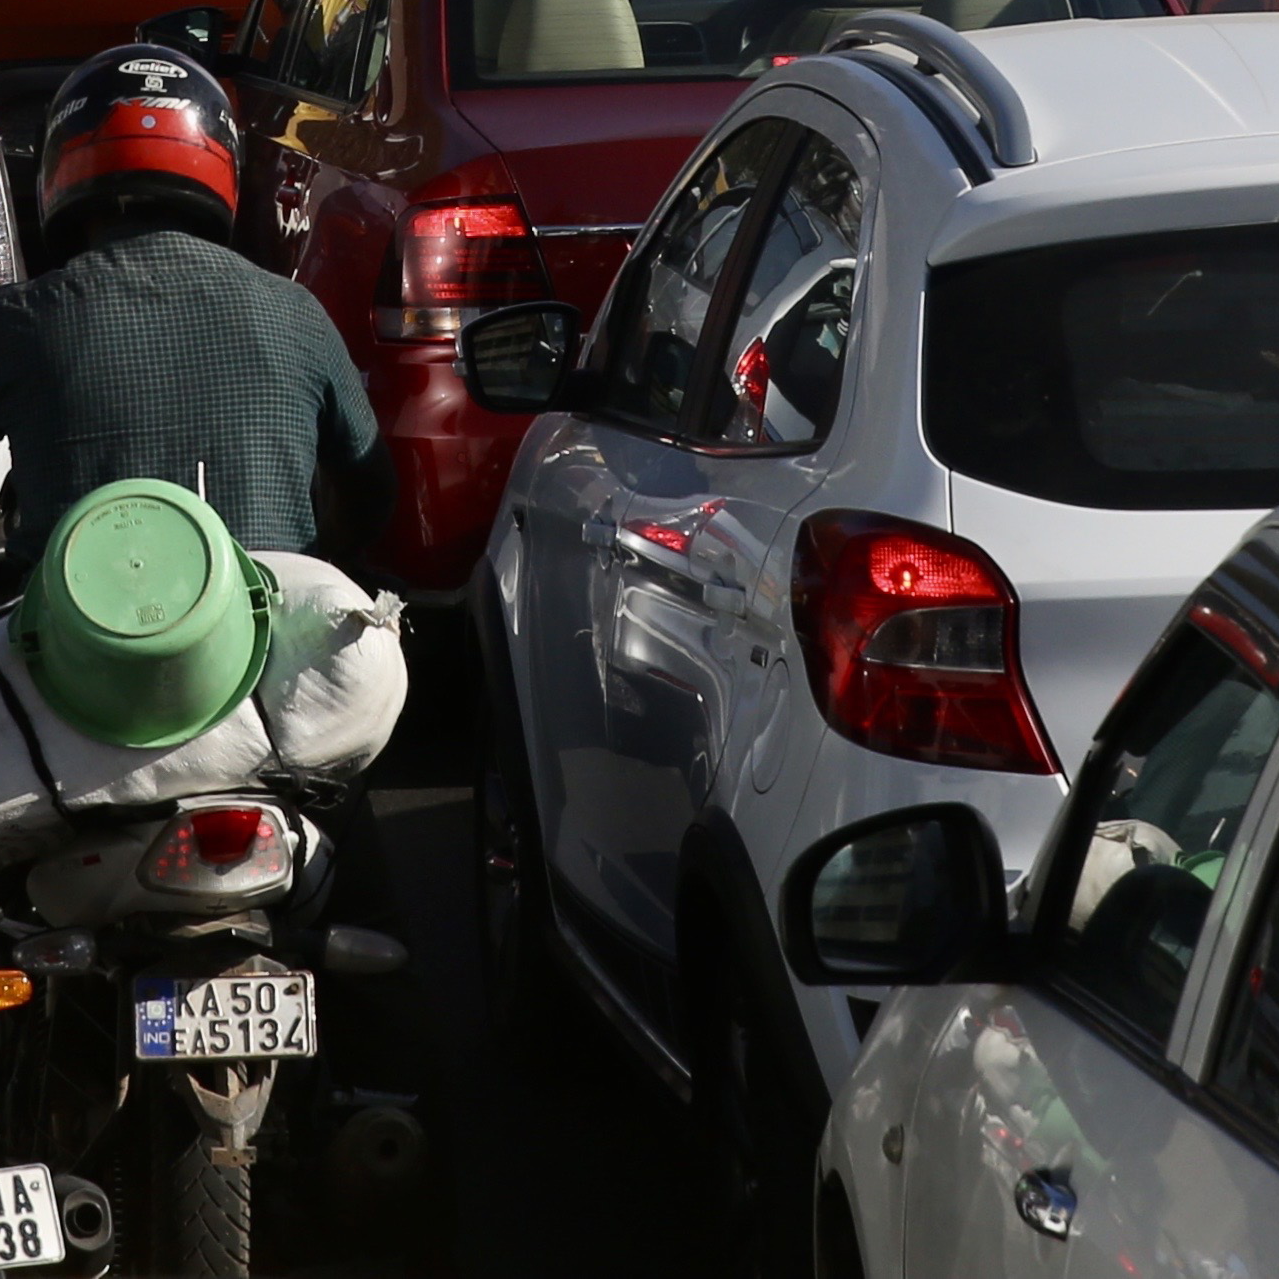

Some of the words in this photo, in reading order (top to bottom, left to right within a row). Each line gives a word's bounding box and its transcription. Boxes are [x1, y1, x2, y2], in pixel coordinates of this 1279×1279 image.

[131, 63, 178, 76] Relief
[175, 981, 225, 1019] KA
[229, 981, 276, 1016] 50
[143, 1030, 172, 1045] IND
